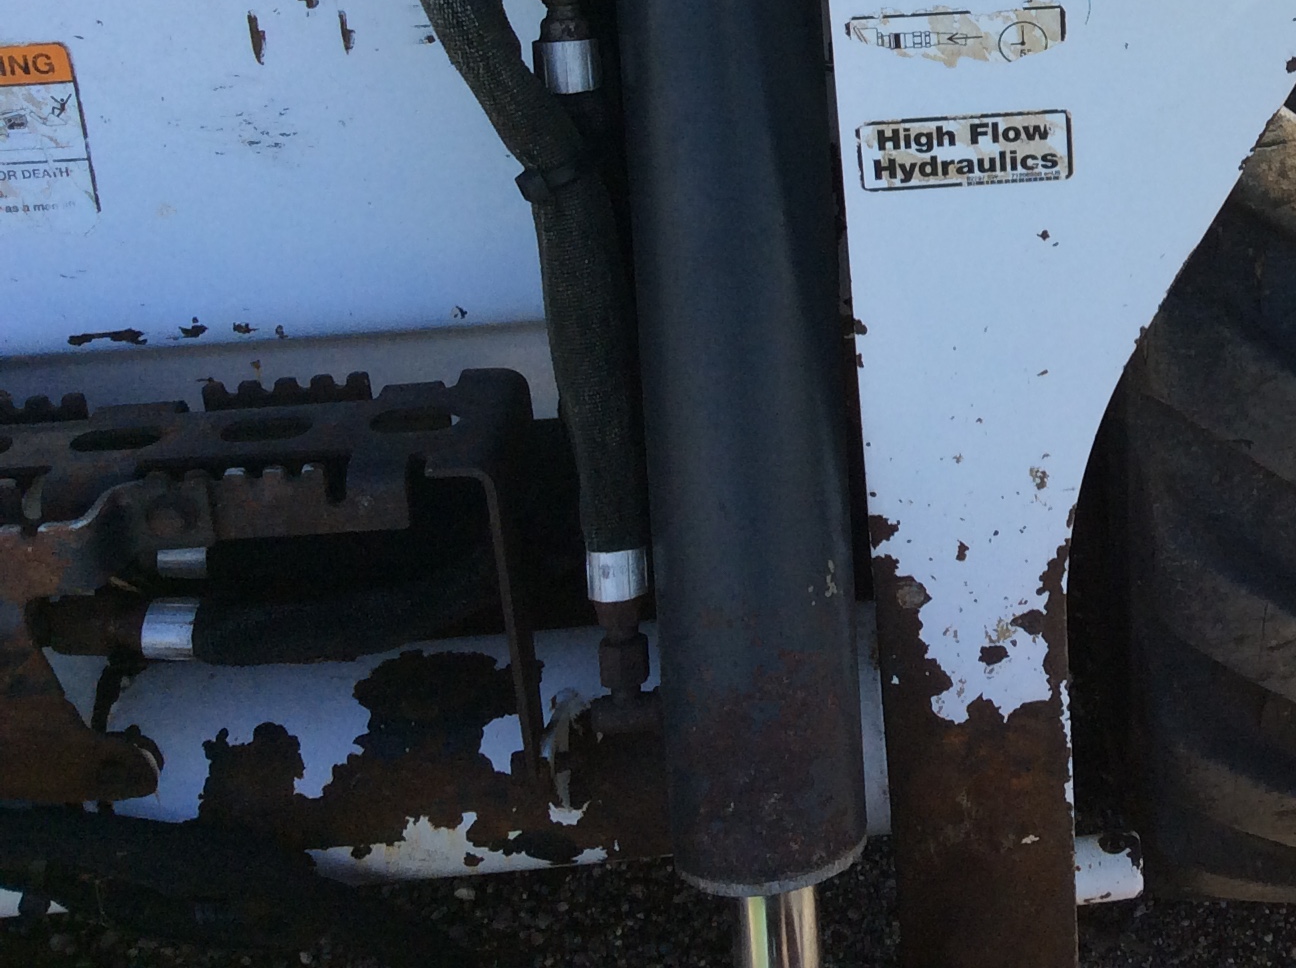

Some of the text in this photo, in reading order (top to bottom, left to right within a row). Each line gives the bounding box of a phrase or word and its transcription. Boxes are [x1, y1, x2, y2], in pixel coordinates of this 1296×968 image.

[876, 121, 1049, 153] High Flow
[21, 166, 70, 180] DEATH
[873, 149, 1059, 183] Hydraulics
